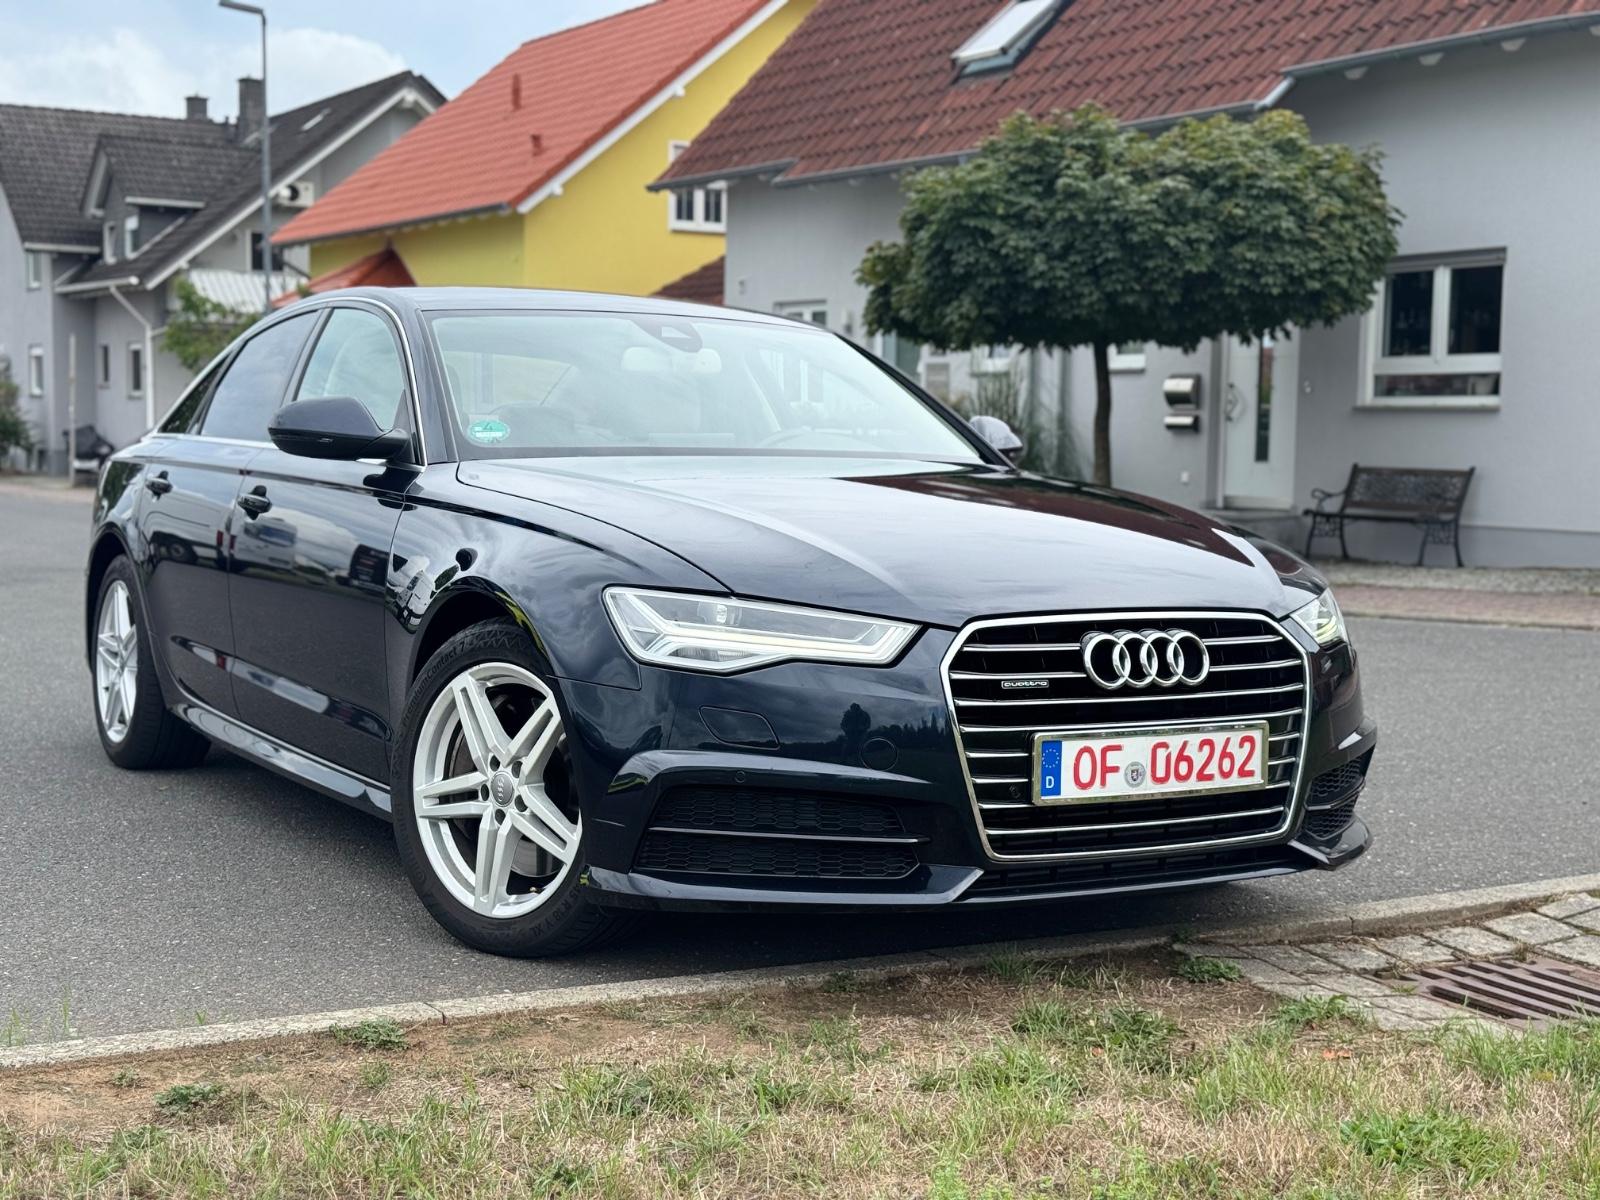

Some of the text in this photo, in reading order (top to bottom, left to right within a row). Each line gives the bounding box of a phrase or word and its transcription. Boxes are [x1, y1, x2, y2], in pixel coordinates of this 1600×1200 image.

[1073, 735, 1256, 790] OF 06262
[1045, 775, 1054, 789] D
